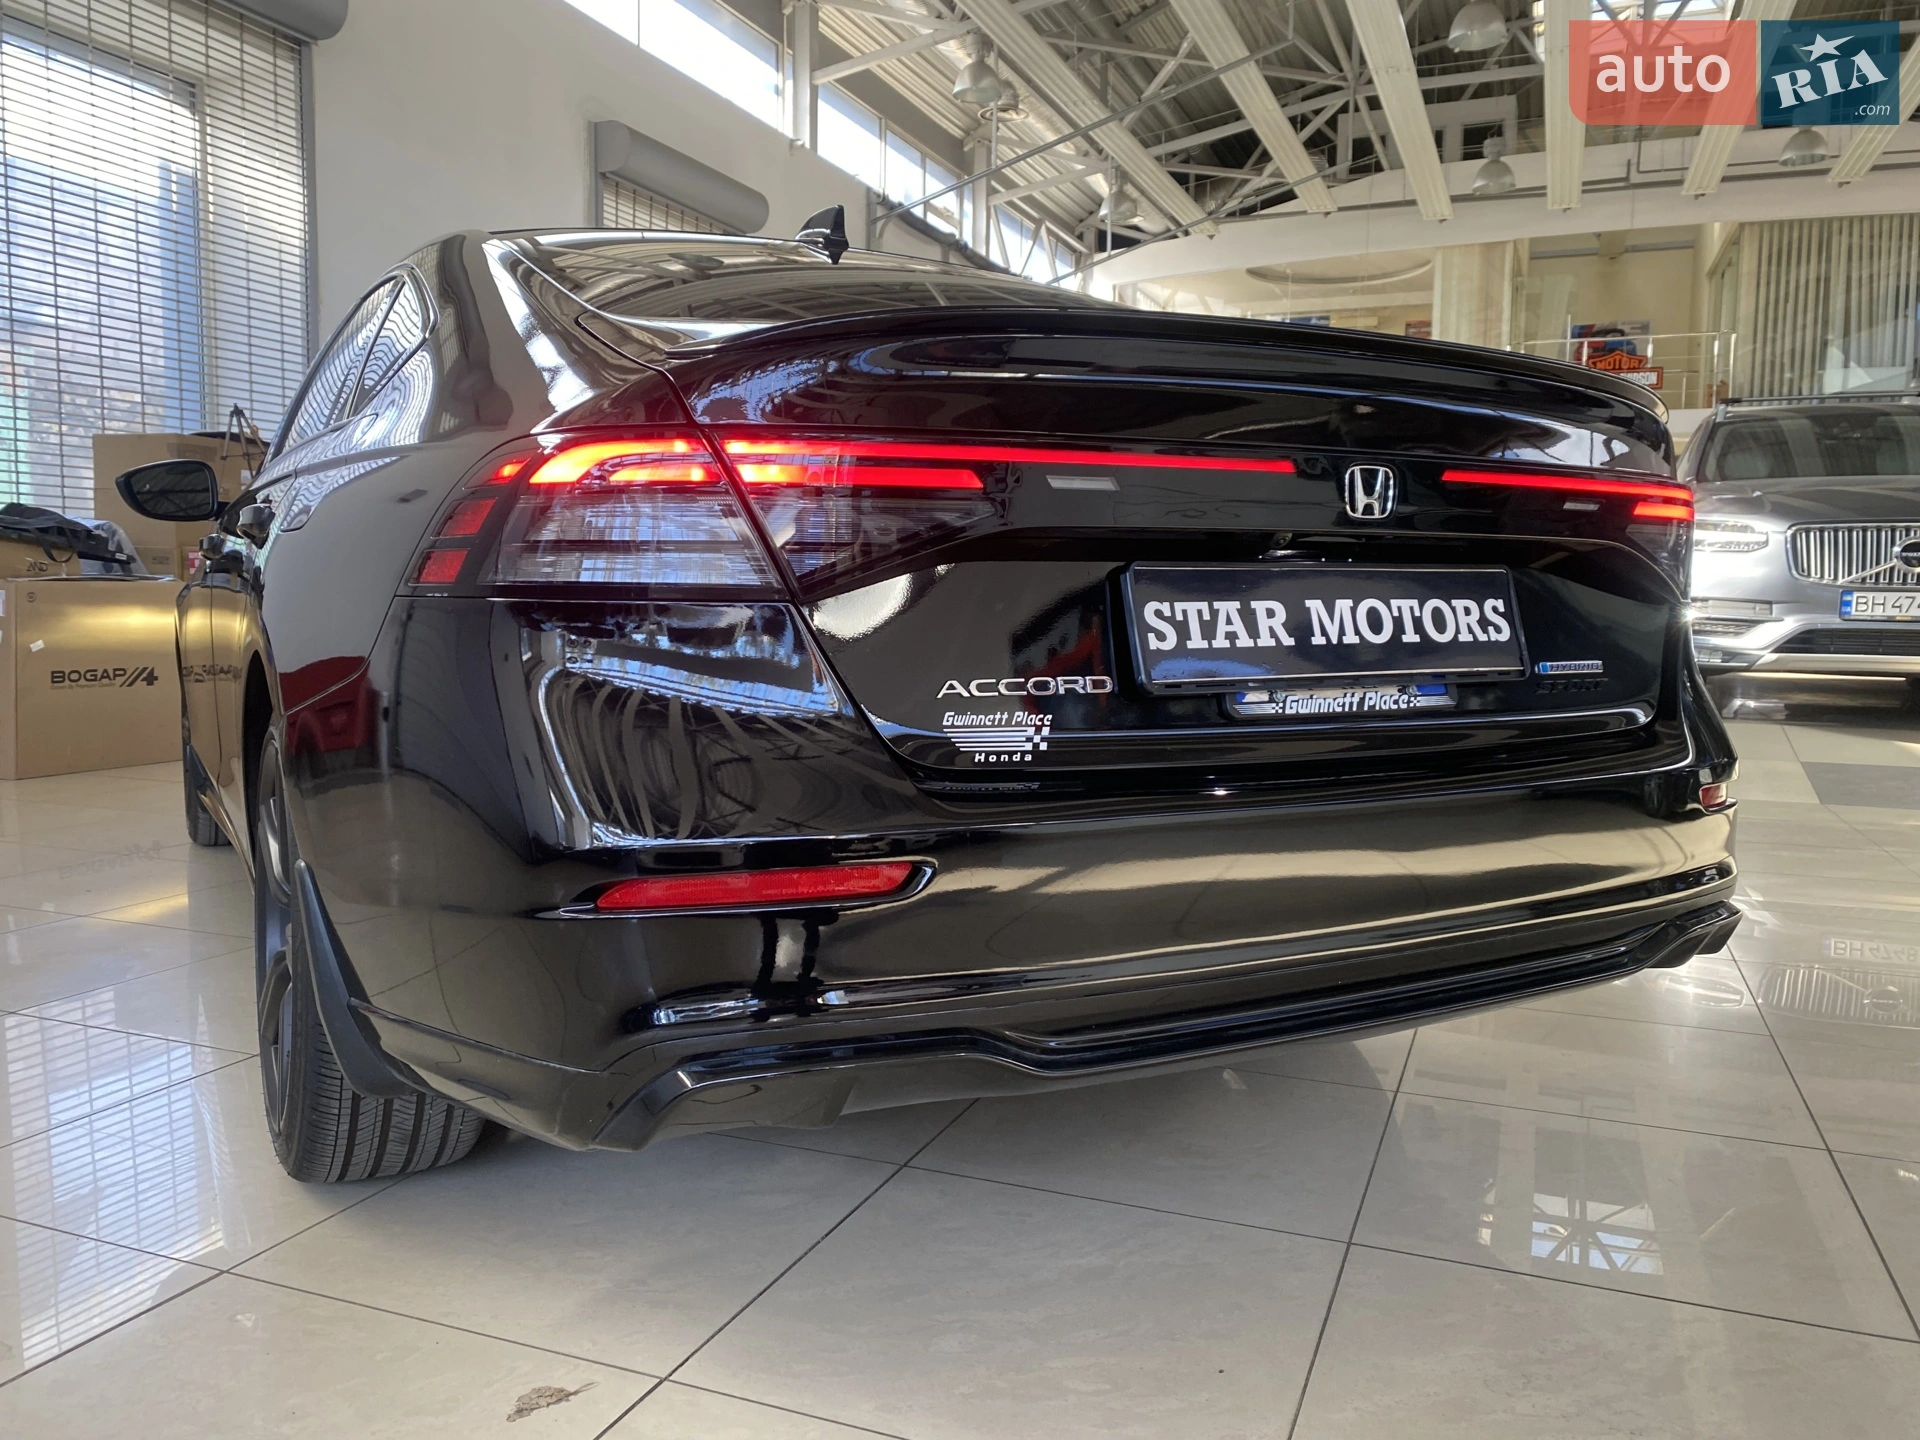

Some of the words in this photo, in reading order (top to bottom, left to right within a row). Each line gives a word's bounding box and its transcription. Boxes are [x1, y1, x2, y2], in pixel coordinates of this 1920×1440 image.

[1596, 355, 1639, 370] MOTOR
[1855, 595, 1886, 613] BH
[1891, 595, 1920, 614] 47
[1143, 601, 1295, 651] STAR
[1304, 598, 1511, 645] MOTORS
[50, 667, 128, 684] BOGAP
[1550, 662, 1601, 672] HYBRID
[936, 675, 1113, 699] ACCORD
[1285, 692, 1361, 714] Gwinnett
[1363, 691, 1408, 711] Place
[942, 711, 1009, 726] Gwinnett
[1011, 711, 1053, 726] Place
[974, 752, 1033, 763] Honda
